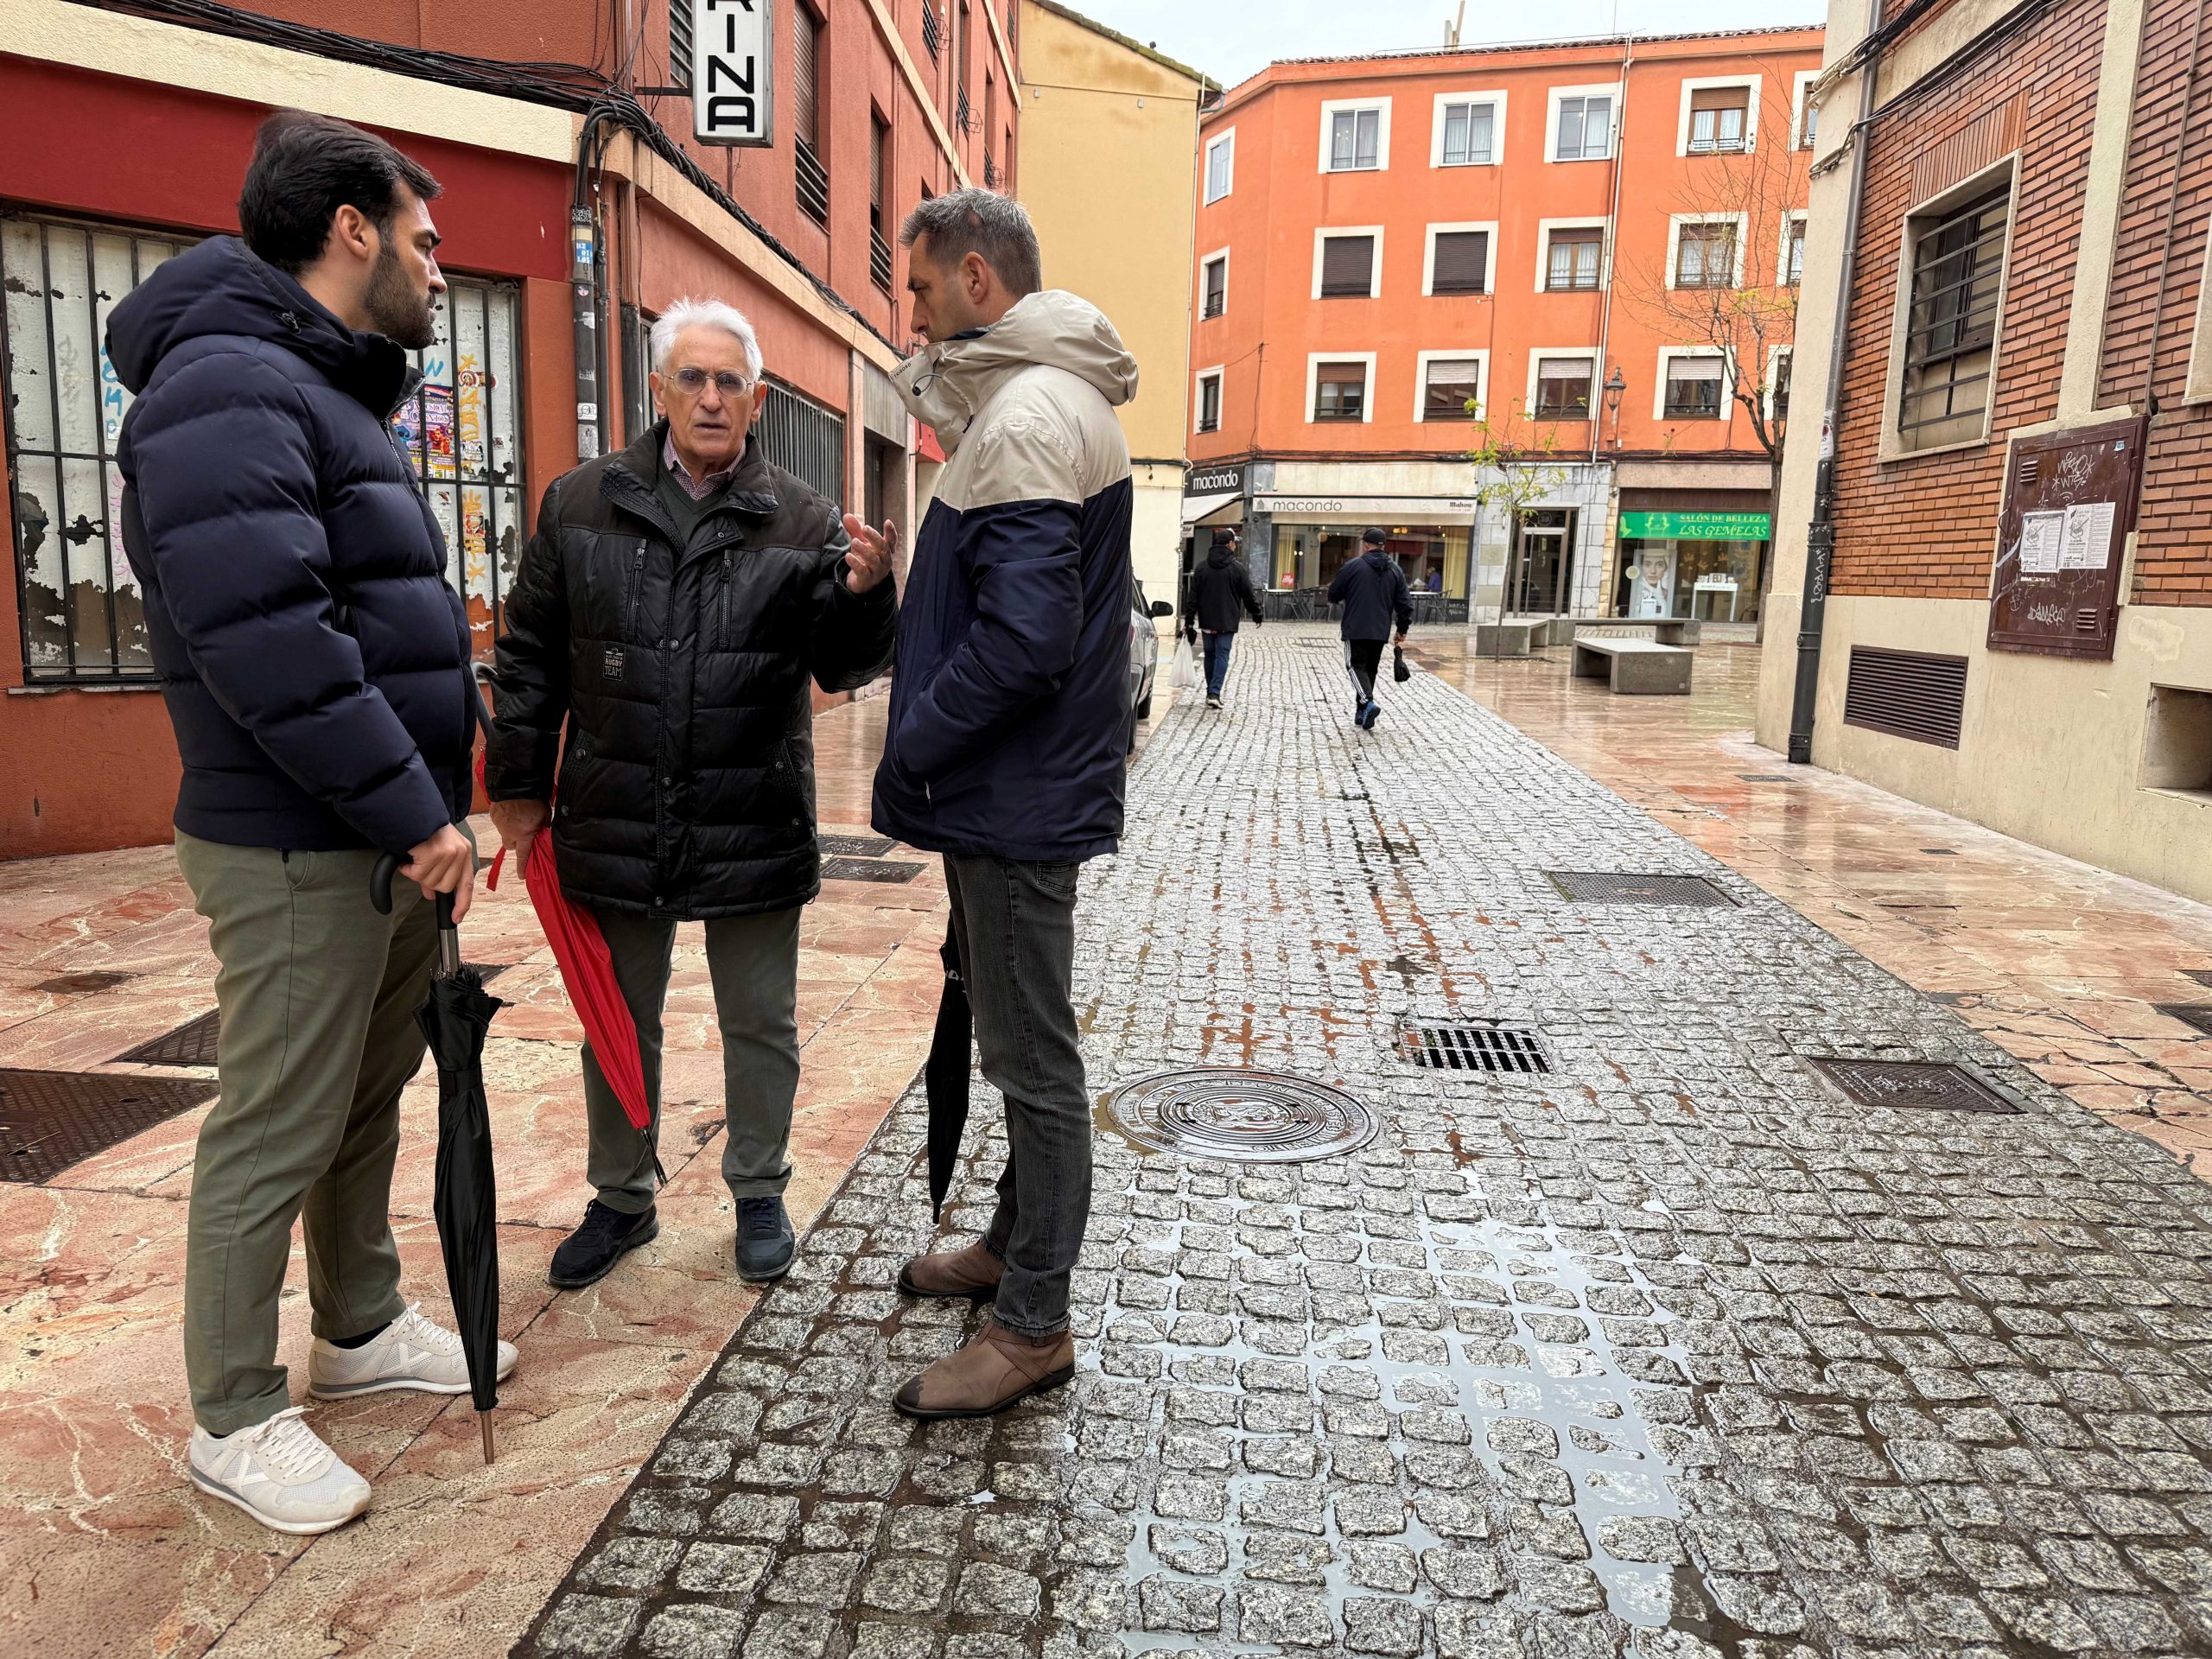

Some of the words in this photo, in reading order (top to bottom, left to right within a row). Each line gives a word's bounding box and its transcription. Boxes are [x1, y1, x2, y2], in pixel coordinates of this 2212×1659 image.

[707, 0, 755, 132] INA
[1192, 469, 1239, 491] macondo
[1273, 499, 1343, 512] macondo
[1712, 514, 1725, 523] DE
[1726, 514, 1767, 523] BELLEZA
[1679, 525, 1702, 536] LAS
[1705, 524, 1767, 537] GEMELAS
[604, 665, 622, 677] TEAM
